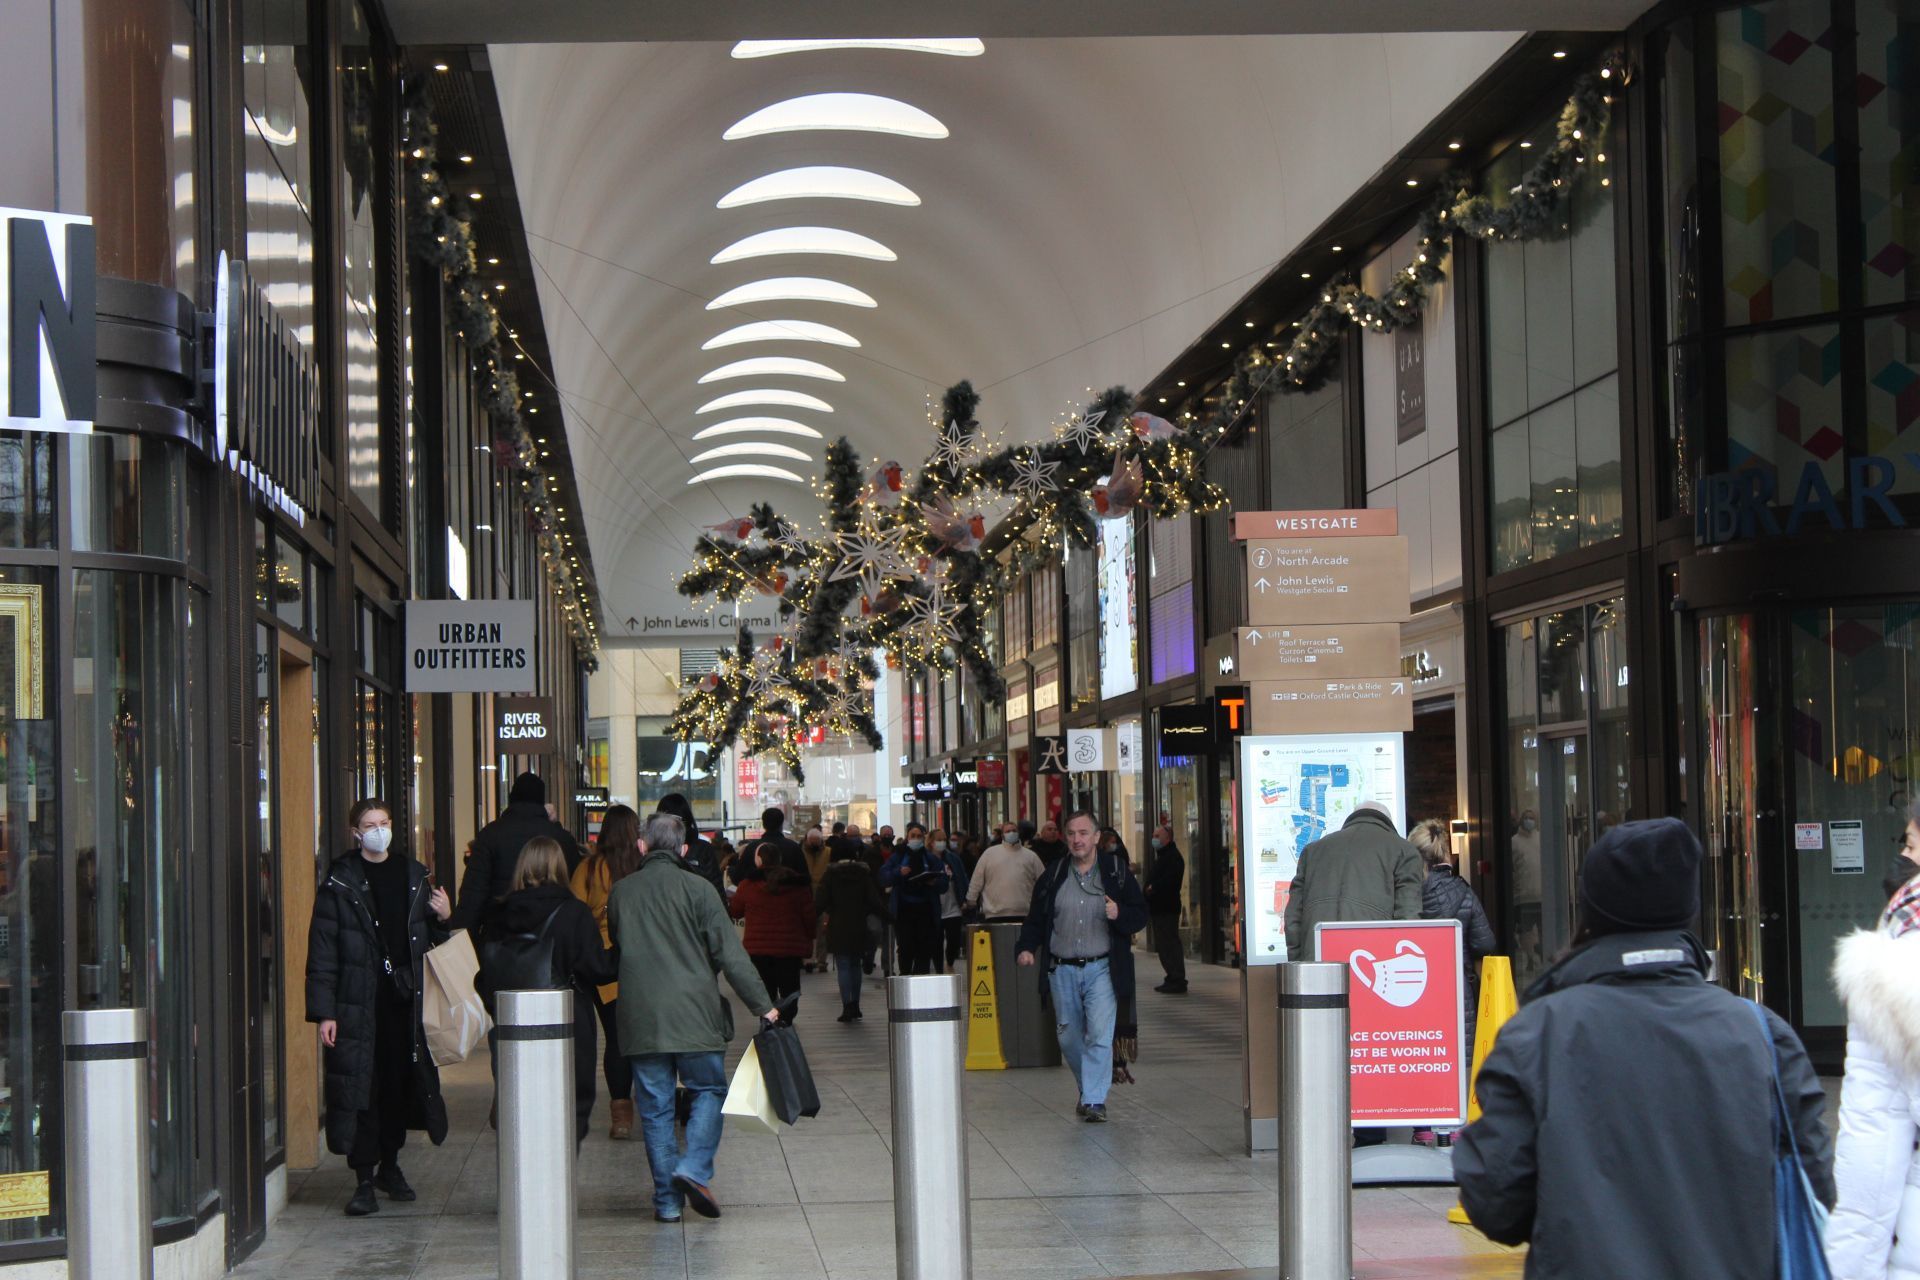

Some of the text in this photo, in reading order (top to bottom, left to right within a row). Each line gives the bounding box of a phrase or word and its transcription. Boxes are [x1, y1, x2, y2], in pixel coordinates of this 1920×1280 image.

[1275, 517, 1359, 531] WESTGATE
[1276, 547, 1290, 555] You
[1304, 547, 1313, 555] at
[1276, 555, 1350, 567] North Arcade
[1276, 575, 1335, 587] John Lewis
[1276, 586, 1336, 597] Westgate Social
[642, 616, 672, 633] John
[675, 615, 709, 629] Lewis
[718, 614, 772, 627] Cinema
[438, 622, 502, 644] URBAN
[1267, 631, 1281, 639] Lift
[1279, 638, 1326, 647] Roof Terrace
[1279, 646, 1336, 656] Curzon Cinema
[413, 647, 527, 670] OUTFITTERS
[1279, 655, 1304, 664] Toilets
[1339, 682, 1383, 691] Park & Ride
[1299, 690, 1383, 701] Oxford Castle Quarter
[503, 712, 542, 726] RIVER
[1220, 698, 1246, 730] T
[499, 726, 547, 739] ISLAND
[1073, 735, 1097, 764] 3
[660, 741, 711, 782] JD
[575, 794, 602, 802] ZARA
[1372, 1030, 1443, 1042] COVERINGS
[1371, 1047, 1388, 1058] BE
[1391, 1046, 1431, 1058] WORN
[1433, 1045, 1447, 1057] IN
[1350, 1063, 1396, 1075] STGATE
